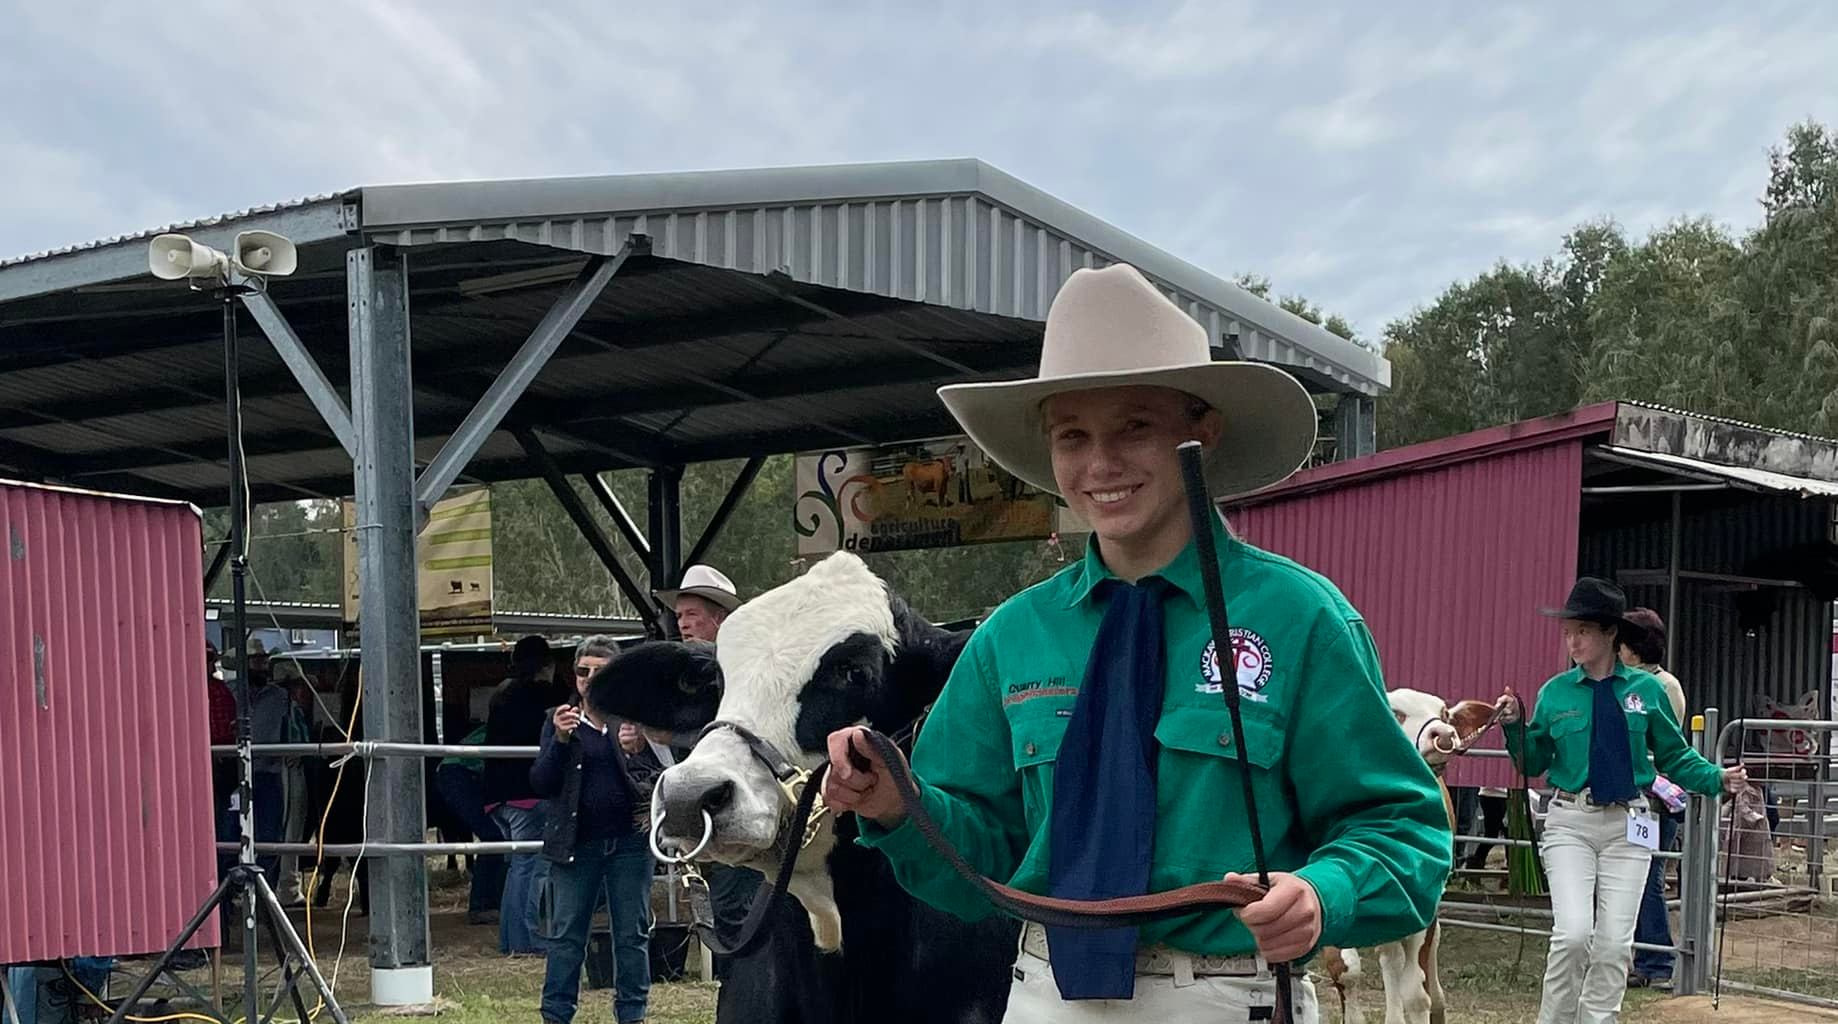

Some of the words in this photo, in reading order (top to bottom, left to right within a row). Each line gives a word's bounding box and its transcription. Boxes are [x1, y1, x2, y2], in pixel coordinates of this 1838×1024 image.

[1254, 644, 1273, 688] COLLEGE
[1047, 677, 1066, 687] Hill
[1635, 823, 1649, 839] 78
